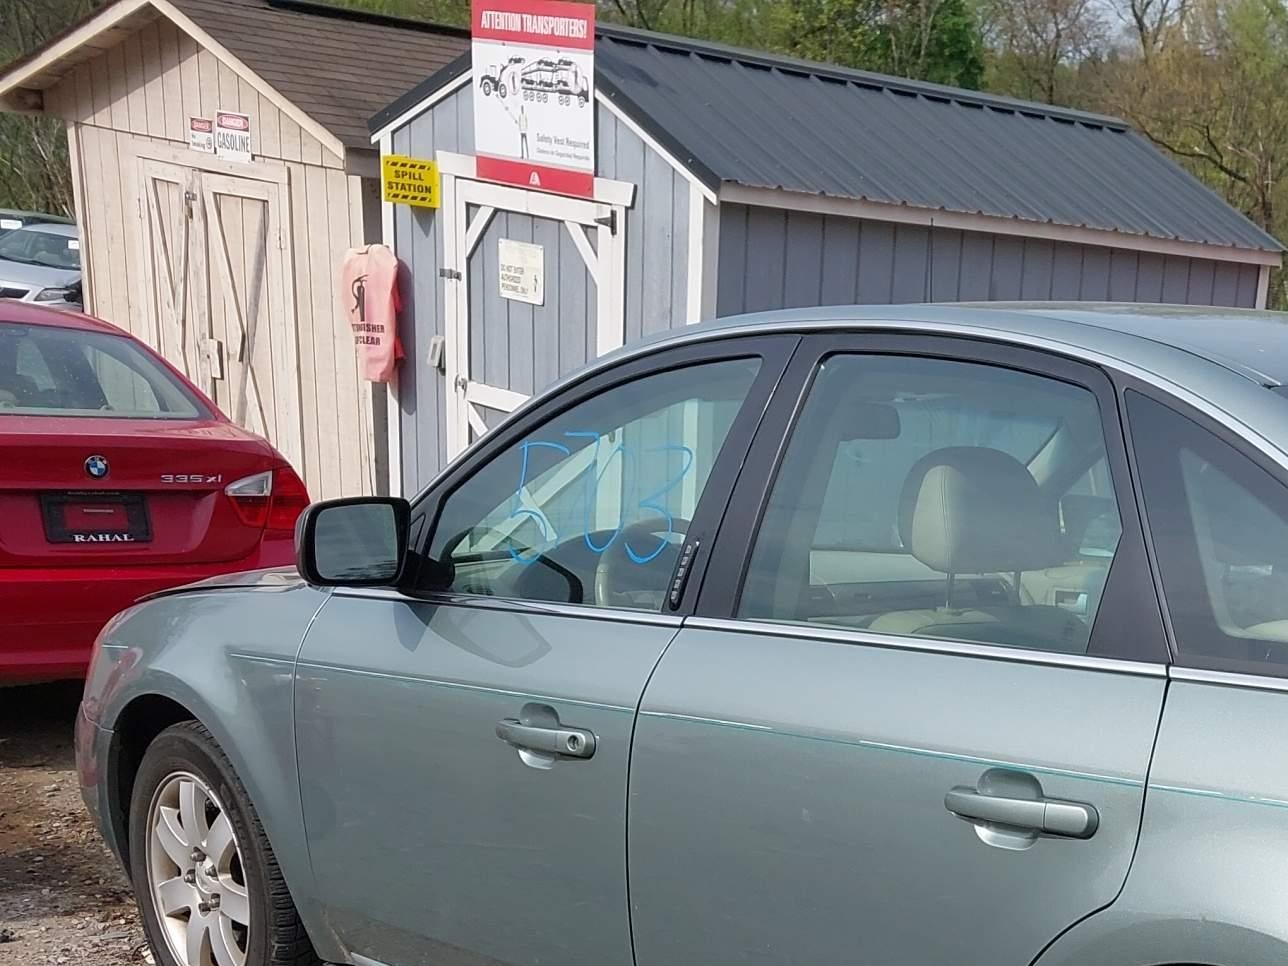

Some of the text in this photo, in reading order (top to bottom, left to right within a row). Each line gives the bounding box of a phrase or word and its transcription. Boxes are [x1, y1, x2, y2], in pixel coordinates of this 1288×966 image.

[481, 10, 588, 39] ATTENTION TRANSPORTERS!
[217, 132, 250, 153] GASOLINE
[394, 170, 424, 181] SPILL
[387, 181, 432, 194] STATION
[72, 533, 134, 542] RAHAL
